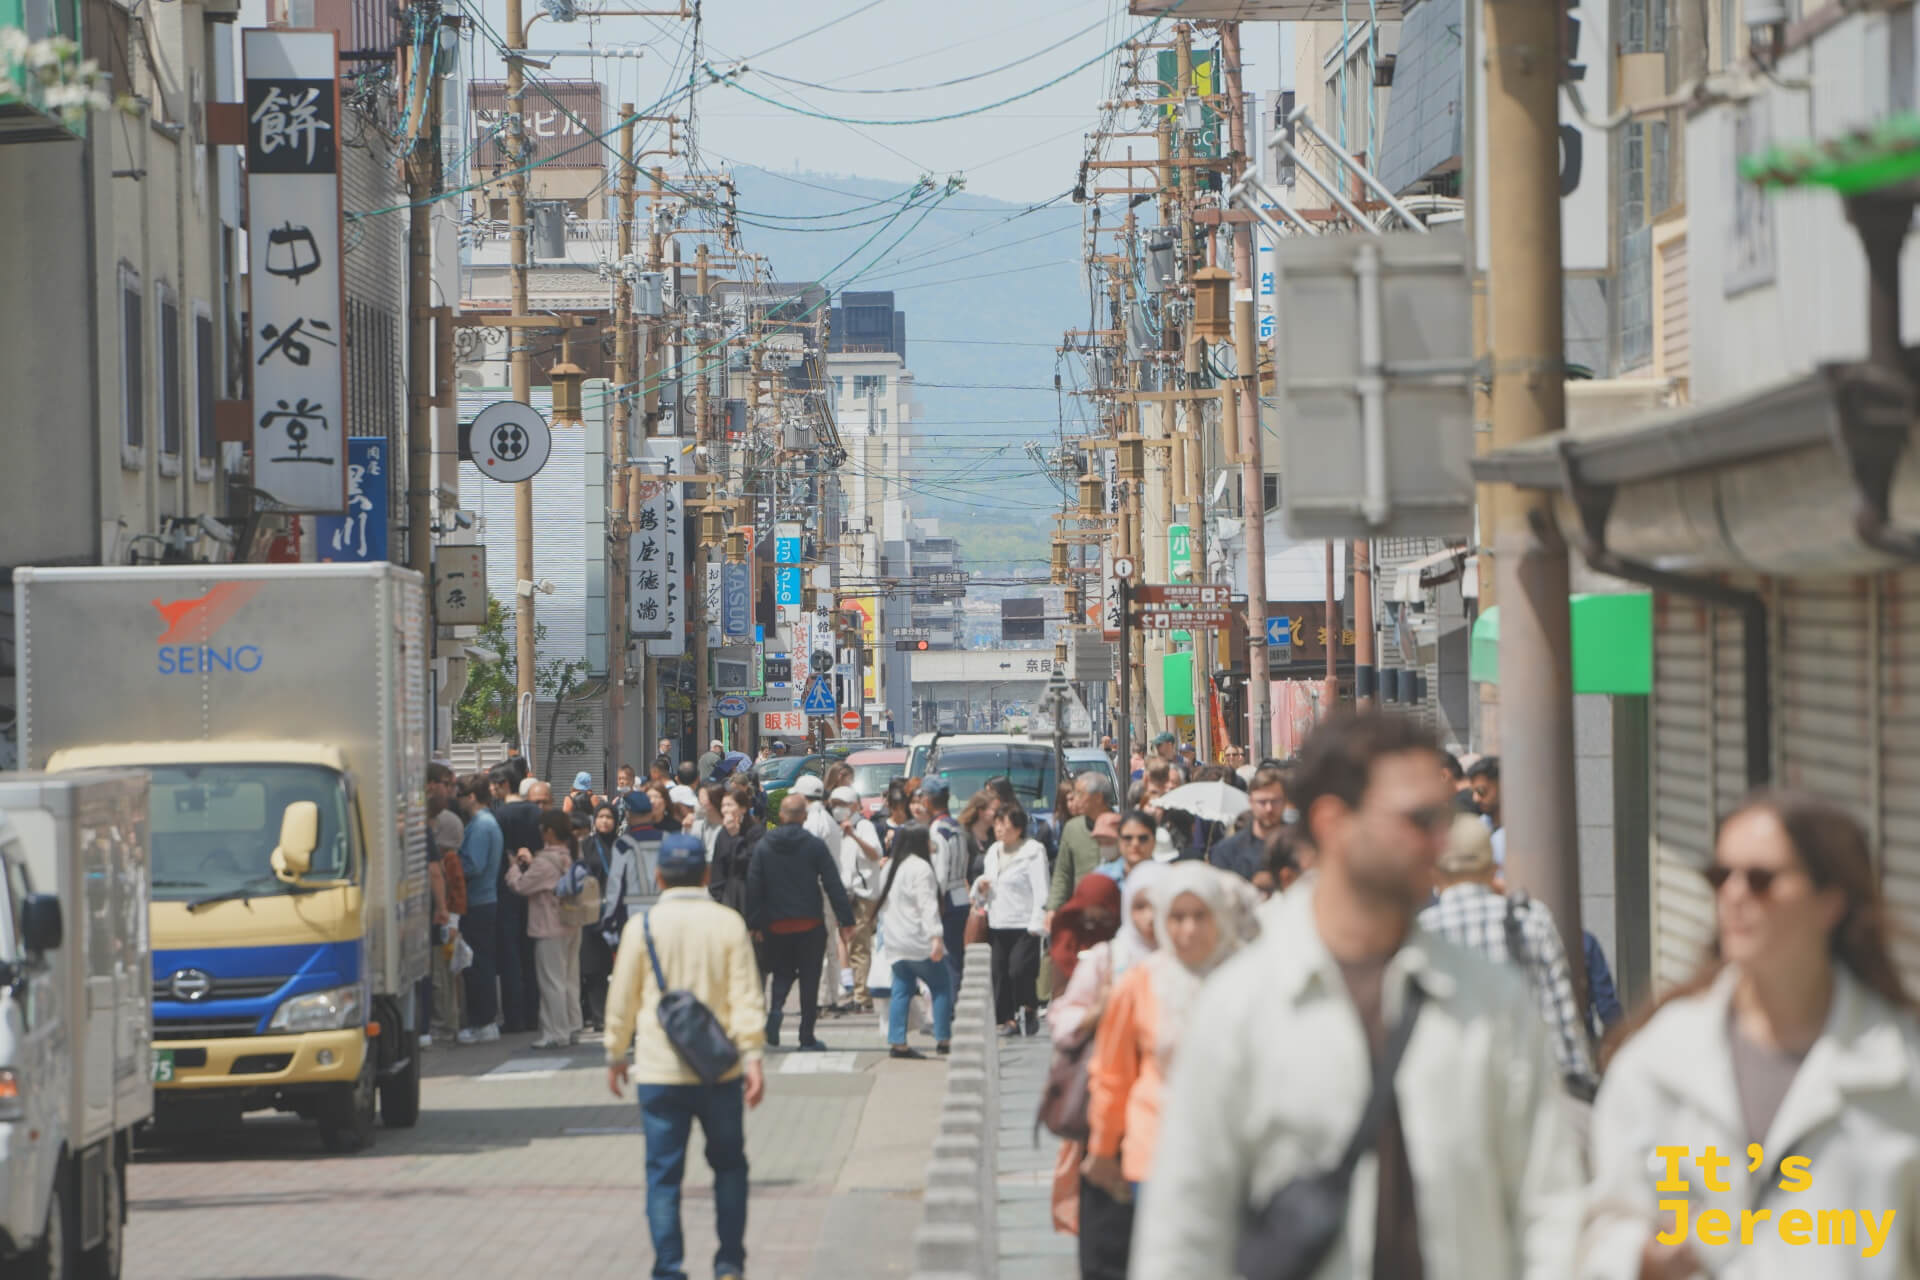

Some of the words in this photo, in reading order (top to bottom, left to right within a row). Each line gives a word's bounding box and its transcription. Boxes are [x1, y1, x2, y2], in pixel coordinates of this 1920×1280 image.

[250, 86, 331, 165] 餅
[258, 221, 338, 465] 中谷堂
[157, 645, 263, 674] SEINO
[764, 713, 803, 731] 眼科
